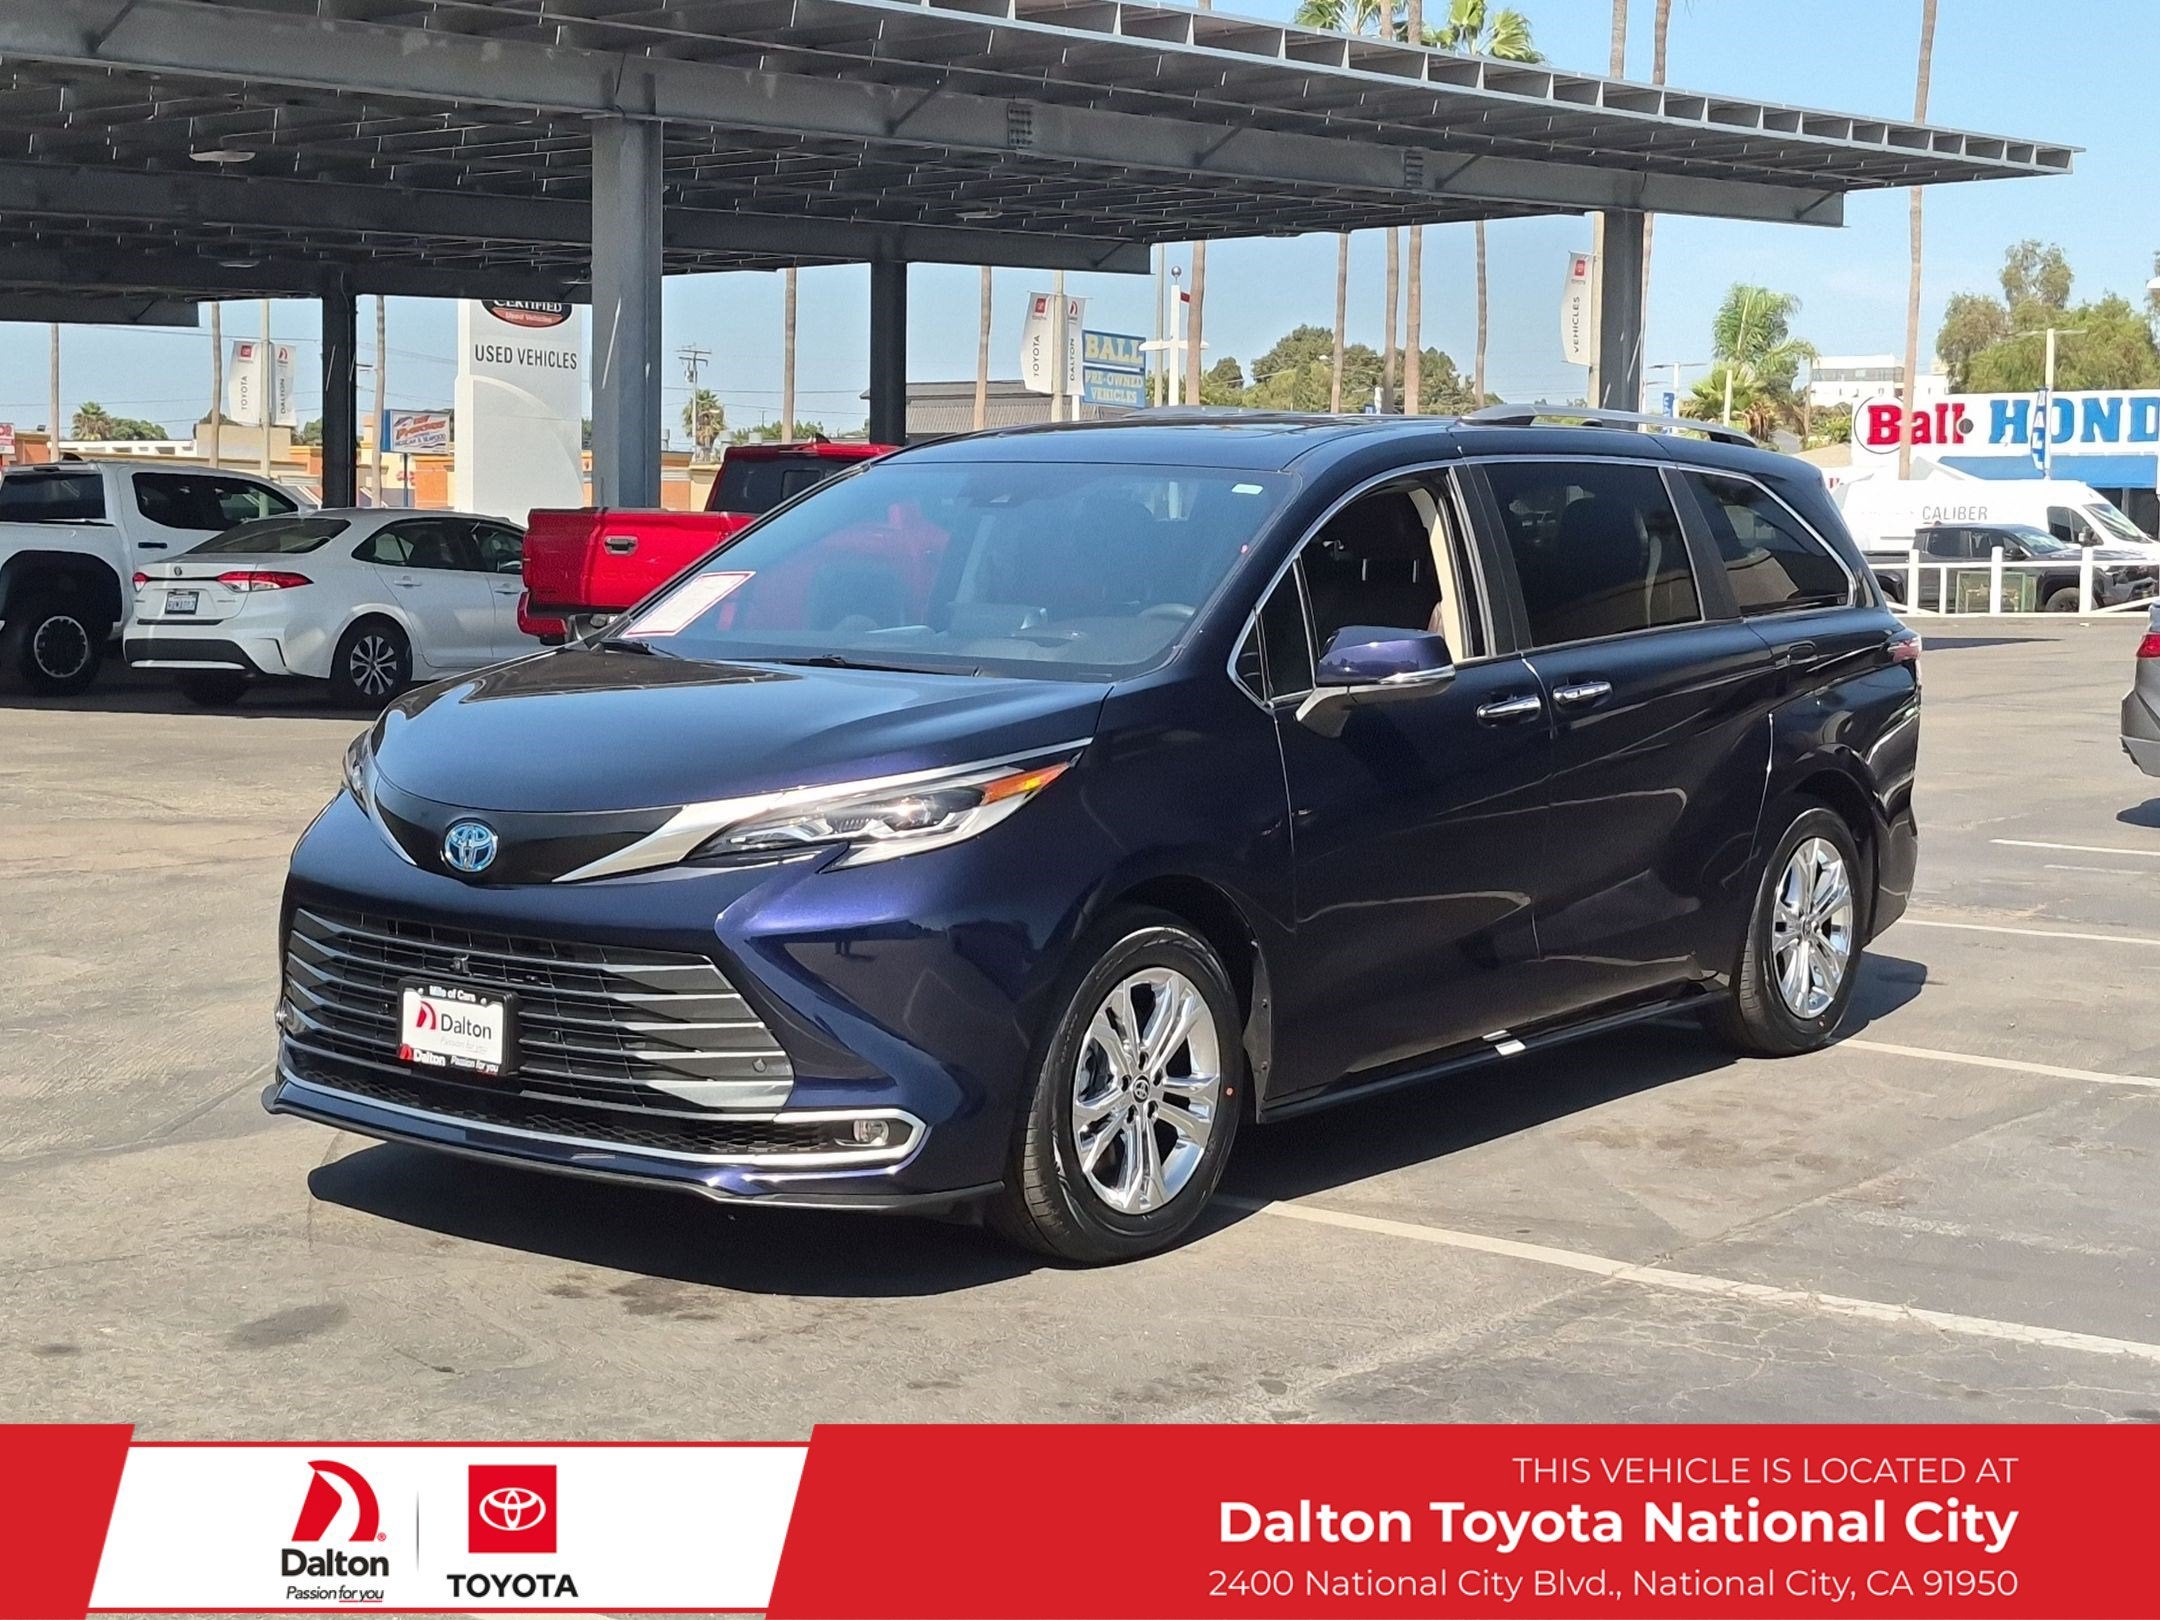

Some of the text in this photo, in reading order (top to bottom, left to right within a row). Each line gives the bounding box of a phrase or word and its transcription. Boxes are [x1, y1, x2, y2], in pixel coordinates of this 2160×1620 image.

[1571, 296, 1580, 353] VEHICLES
[475, 344, 578, 370] USED VEHICLES
[1032, 334, 1041, 376] TOYOTA
[1086, 334, 1143, 364] BALL
[1088, 371, 1143, 388] PRE-OWNED
[1866, 402, 1966, 446] Ball
[1922, 506, 1988, 521] CALIBER
[447, 989, 457, 999] of
[457, 989, 476, 1002] Cars
[441, 1013, 492, 1040] Dalton
[413, 1048, 499, 1073] Dalton Passion for you
